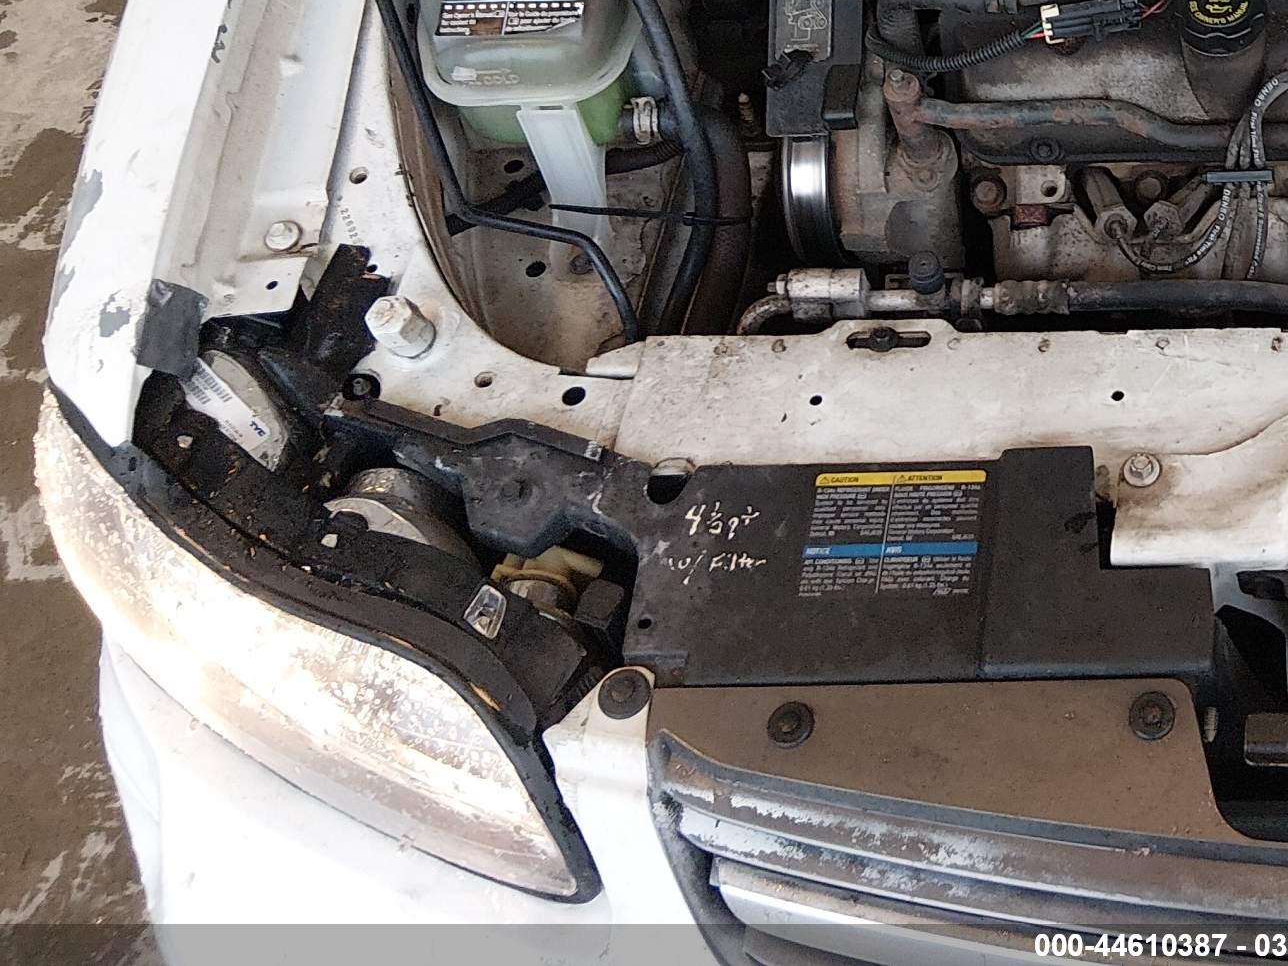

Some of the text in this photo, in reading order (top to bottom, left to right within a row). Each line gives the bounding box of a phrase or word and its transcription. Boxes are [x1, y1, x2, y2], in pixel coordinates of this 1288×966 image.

[1218, 188, 1233, 222] DENSO
[830, 476, 859, 484] CAUTION
[907, 474, 943, 482] ATTENTION
